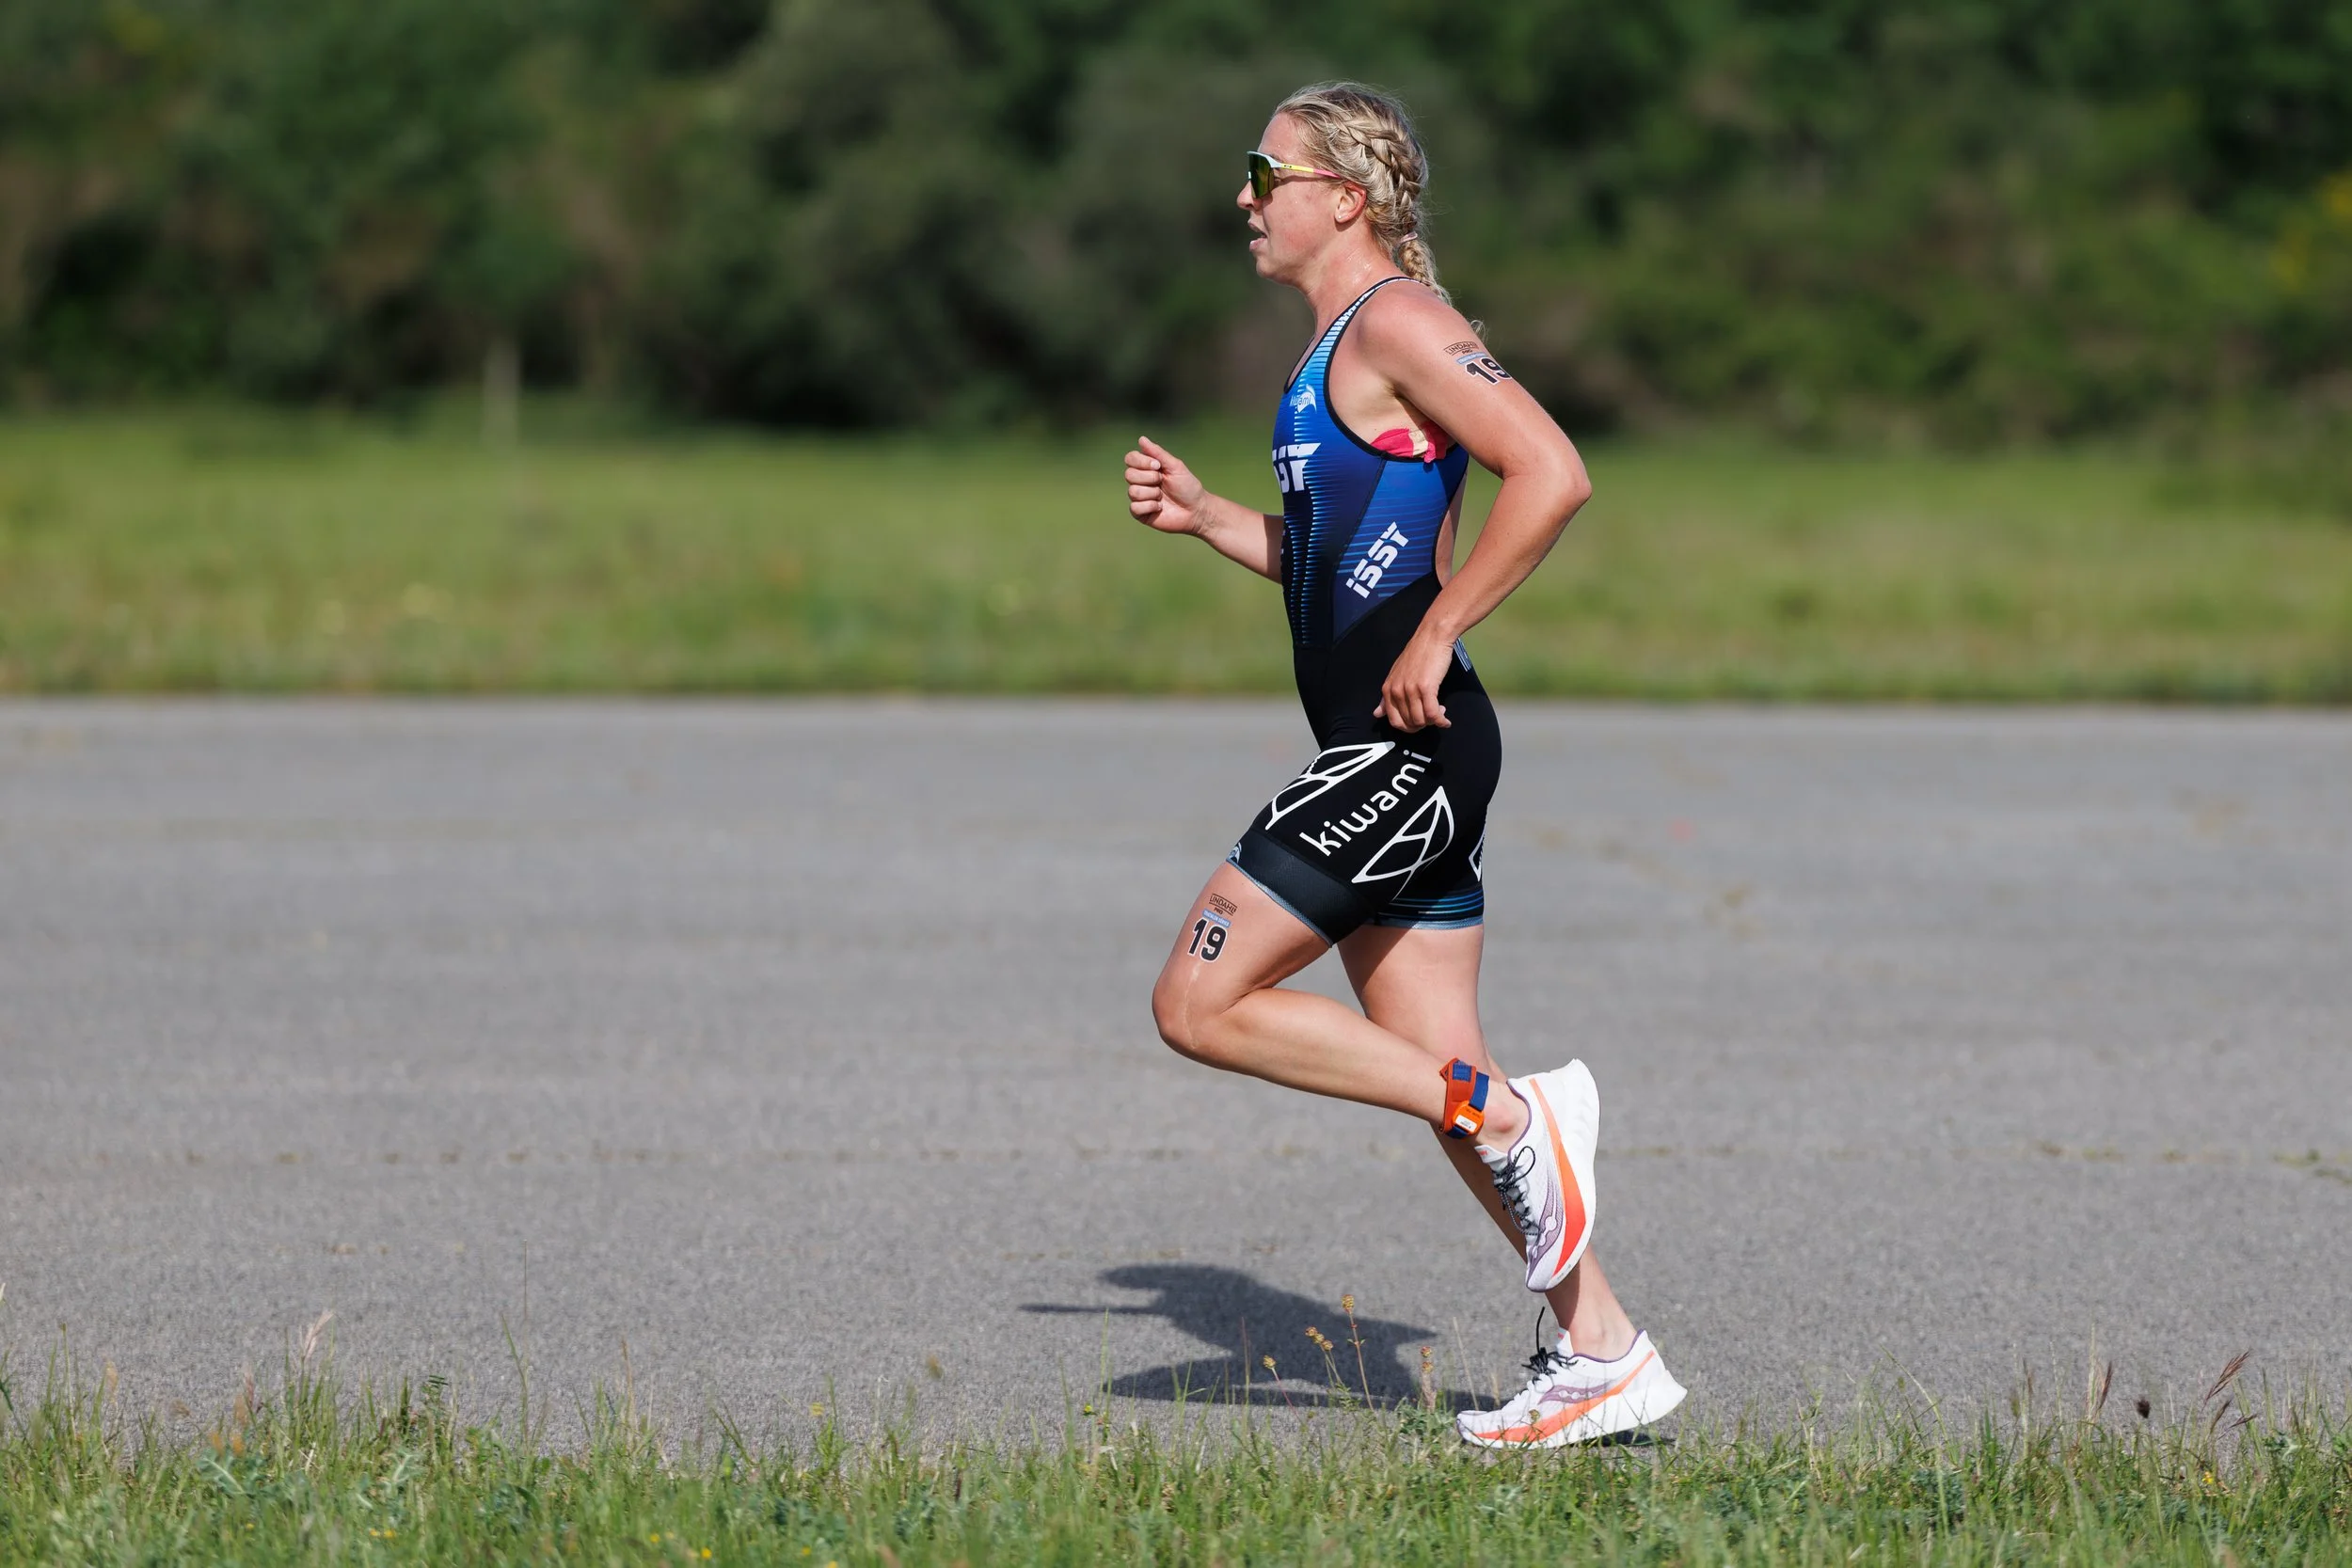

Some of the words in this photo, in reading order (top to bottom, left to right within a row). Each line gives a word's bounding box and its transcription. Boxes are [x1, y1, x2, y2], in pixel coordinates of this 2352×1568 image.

[1466, 357, 1511, 384] 19
[1299, 750, 1431, 857] kiwami
[1188, 918, 1227, 962] 19
